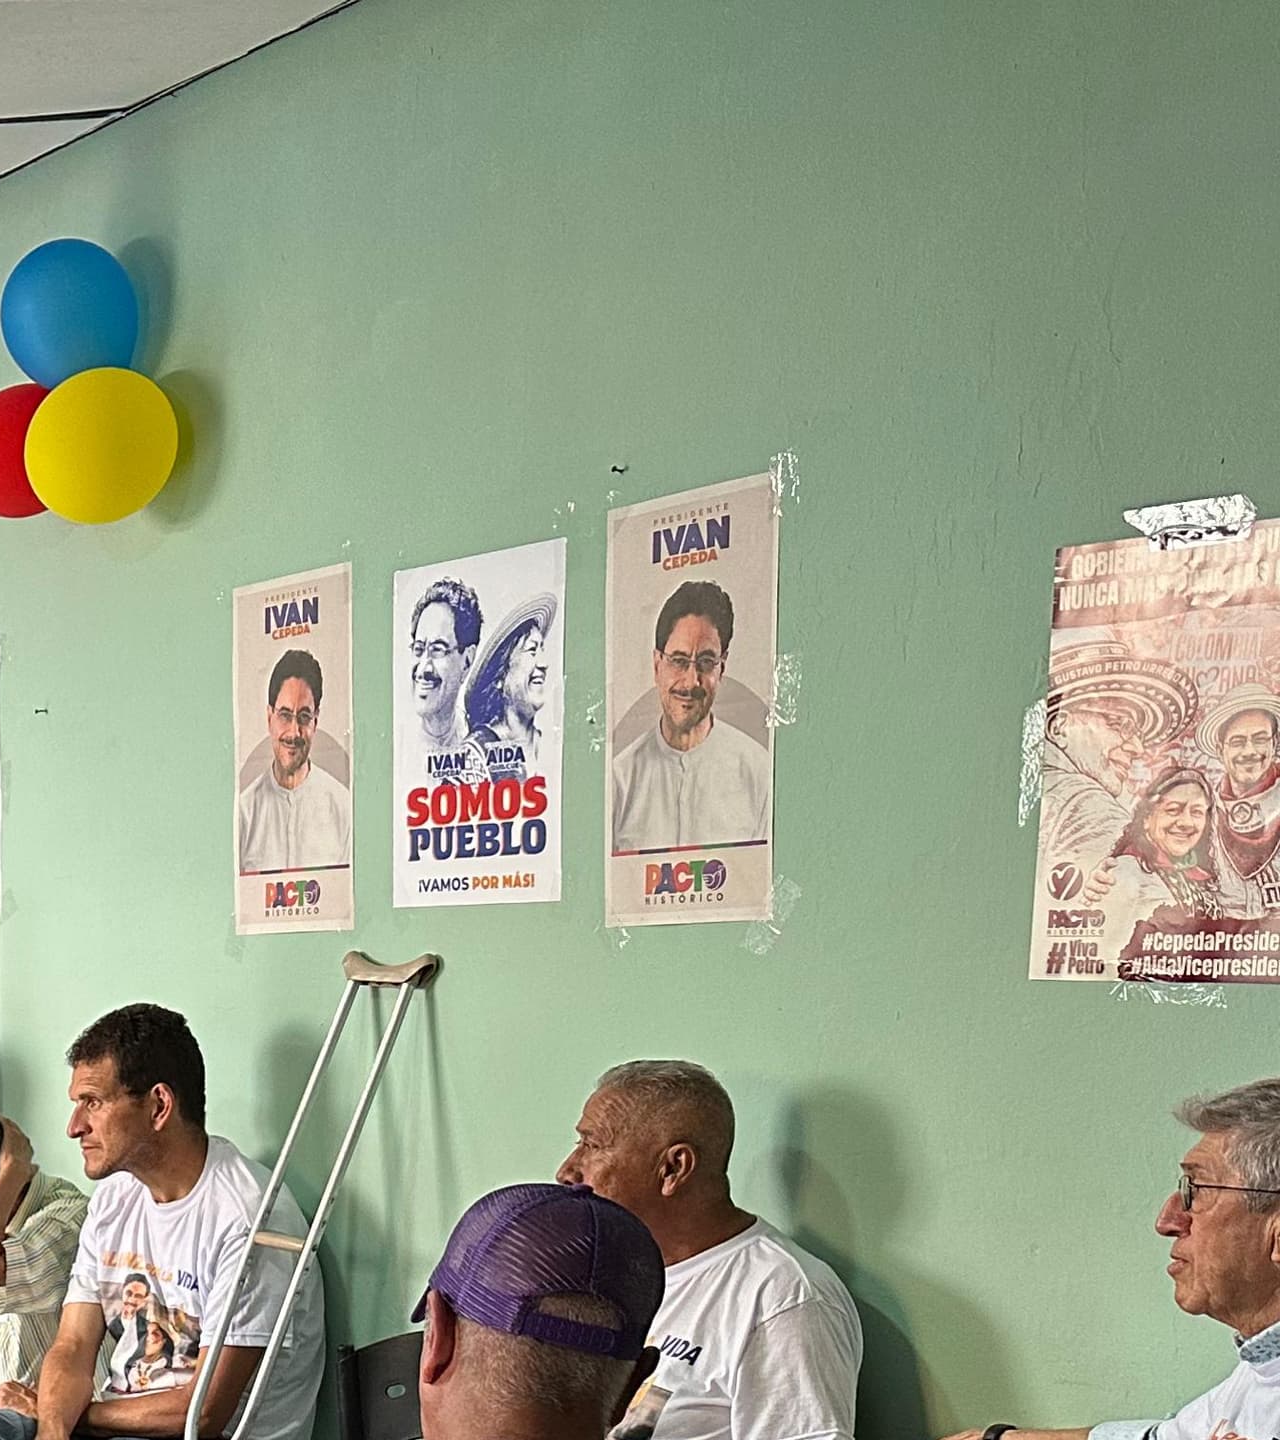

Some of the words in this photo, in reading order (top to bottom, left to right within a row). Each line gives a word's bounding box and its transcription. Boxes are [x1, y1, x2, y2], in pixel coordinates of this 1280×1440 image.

[653, 502, 728, 526] PRESIDENTE
[652, 514, 730, 564] IVÁN
[662, 549, 718, 571] CEPEDA
[1059, 582, 1119, 611] NUNCA
[272, 624, 310, 640] CEPEDA
[1054, 665, 1102, 683] GUSTAVO
[1104, 660, 1141, 673] PETRO
[1142, 663, 1181, 683] URREGO
[407, 776, 548, 827] SOMOS
[408, 819, 547, 862] PUEBLO
[419, 877, 469, 893] ¡VAMOS
[472, 874, 499, 890] POR
[502, 871, 535, 888] MÁS!
[645, 859, 727, 895] PACTO
[265, 880, 320, 908] PACTO
[1048, 909, 1106, 928] PACTO
[1068, 957, 1105, 974] Petro
[660, 1335, 703, 1366] VIDA
